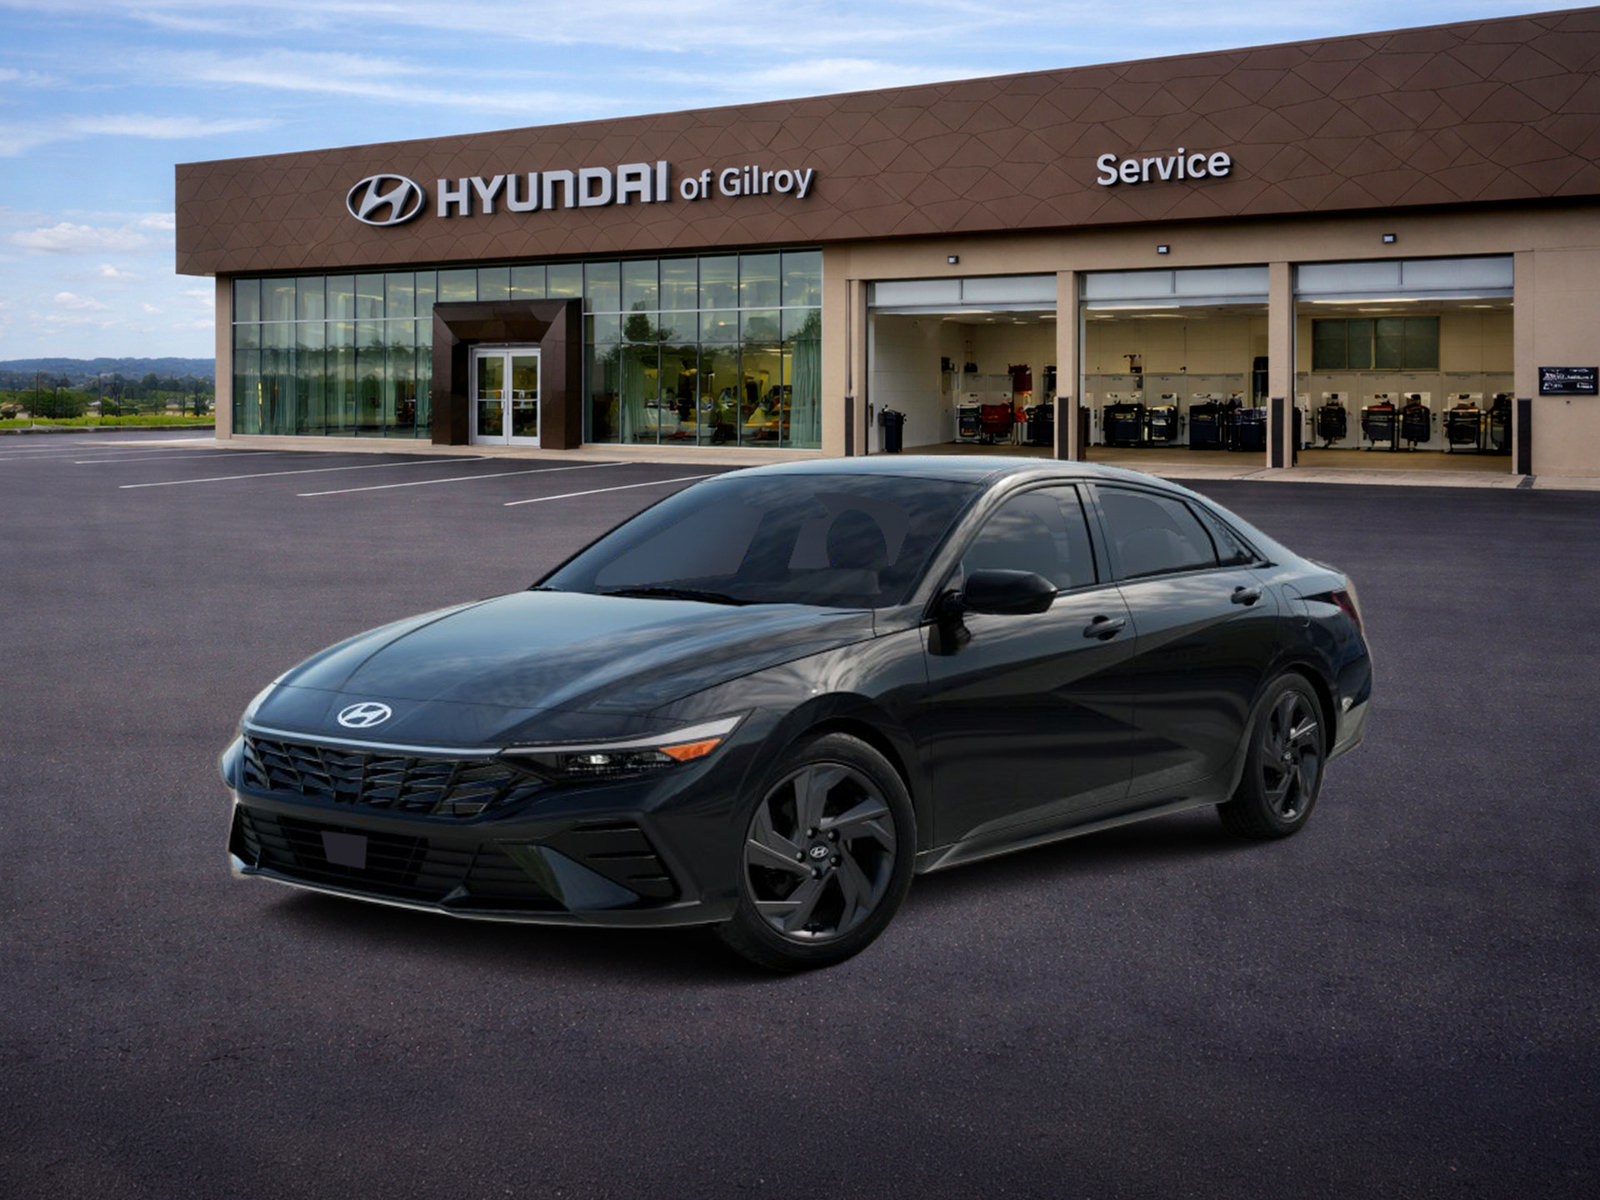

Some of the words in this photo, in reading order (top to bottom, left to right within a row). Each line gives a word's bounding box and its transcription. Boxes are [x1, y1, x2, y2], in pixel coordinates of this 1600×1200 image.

[436, 160, 671, 218] HYUNDAI
[679, 169, 712, 201] of
[718, 165, 814, 199] Gilroy
[1096, 147, 1232, 186] Service
